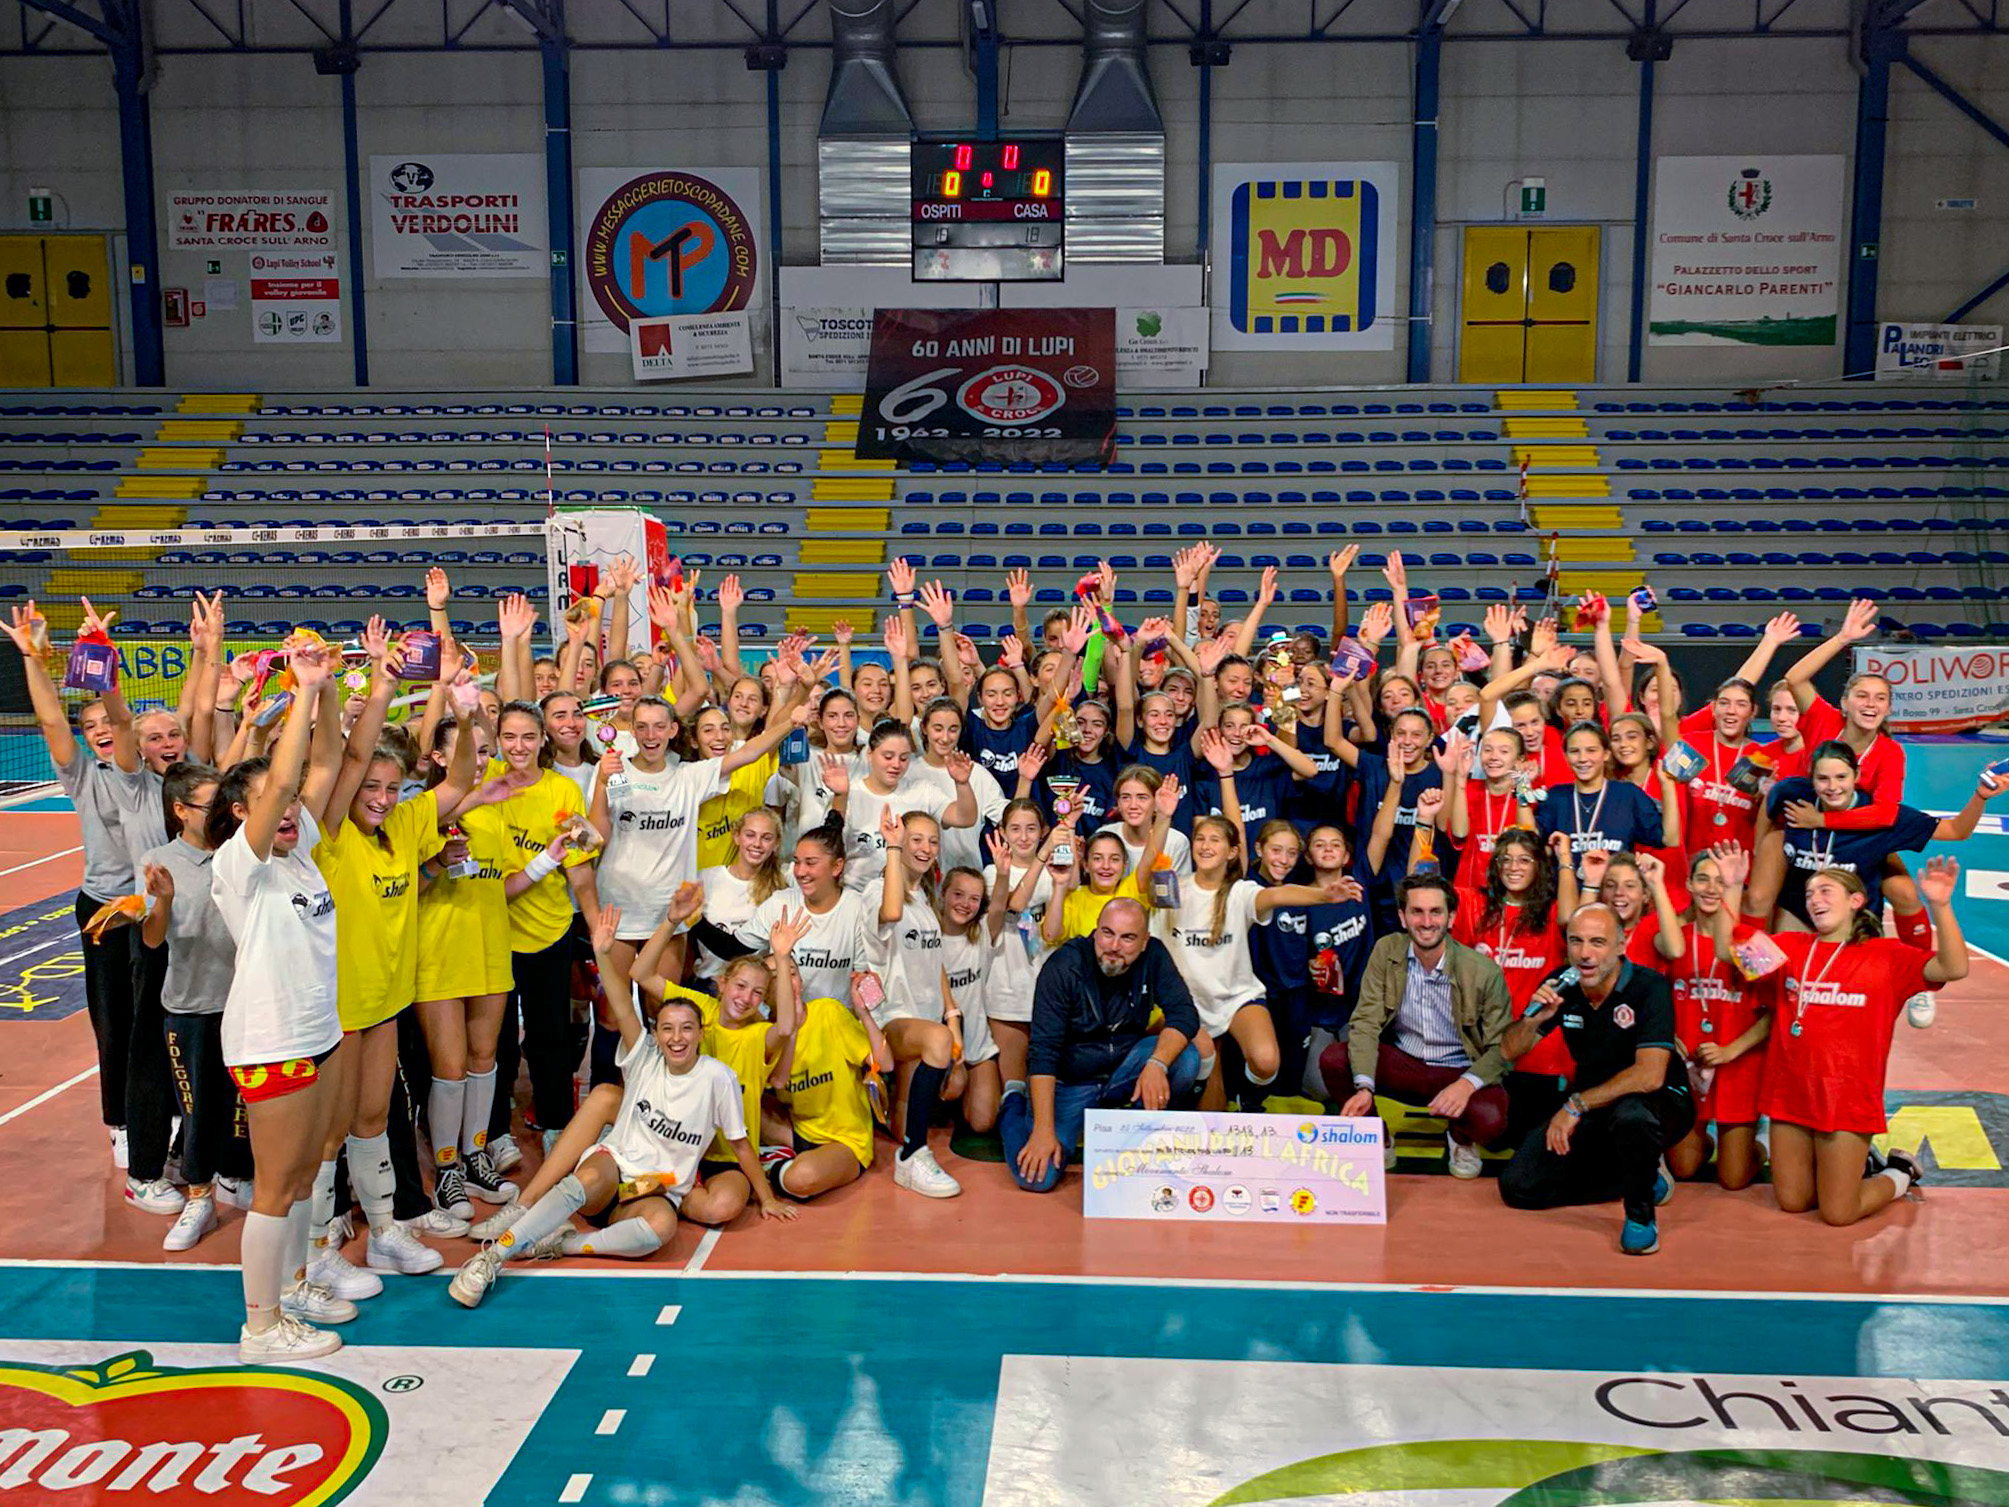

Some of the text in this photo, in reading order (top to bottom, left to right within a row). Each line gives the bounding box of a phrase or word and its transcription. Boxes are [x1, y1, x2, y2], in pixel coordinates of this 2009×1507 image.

[174, 196, 328, 205] GRUPPO DONATORI DI SANGUE
[391, 195, 518, 208] TRASPORTI
[921, 203, 1049, 218] OSPITI CASA
[391, 214, 518, 234] VERDOLINI
[176, 237, 214, 245] SANTA
[218, 237, 258, 245] CROCE
[294, 237, 328, 245] ARNO
[1660, 232, 1703, 243] Comune
[1707, 232, 1718, 243] di
[1722, 232, 1750, 243] Santa
[1754, 232, 1784, 243] Croce
[1257, 228, 1351, 279] MD
[301, 258, 321, 268] School
[1673, 265, 1817, 275] PALAZZETTO DELLO SPORT
[819, 331, 865, 340] SPEDIZIONI
[911, 335, 1075, 358] 60 ANNI DI LUPI
[642, 358, 673, 367] DELTA
[992, 371, 1033, 383] LUPI
[875, 426, 950, 441] 1962
[983, 427, 1063, 439] 2022
[1891, 691, 1923, 701] ENTRO
[1928, 687, 1993, 701] SPEDIZIONI
[1929, 708, 1941, 716] 99
[993, 750, 1018, 772] shal
[1570, 831, 1623, 853] shalom
[1185, 933, 1233, 947] shaom
[799, 950, 851, 969] shalom
[1802, 982, 1867, 1007] shalom
[168, 1032, 194, 1115] FOLGORE
[648, 1120, 702, 1146] shalom
[1321, 1124, 1378, 1144] shalom
